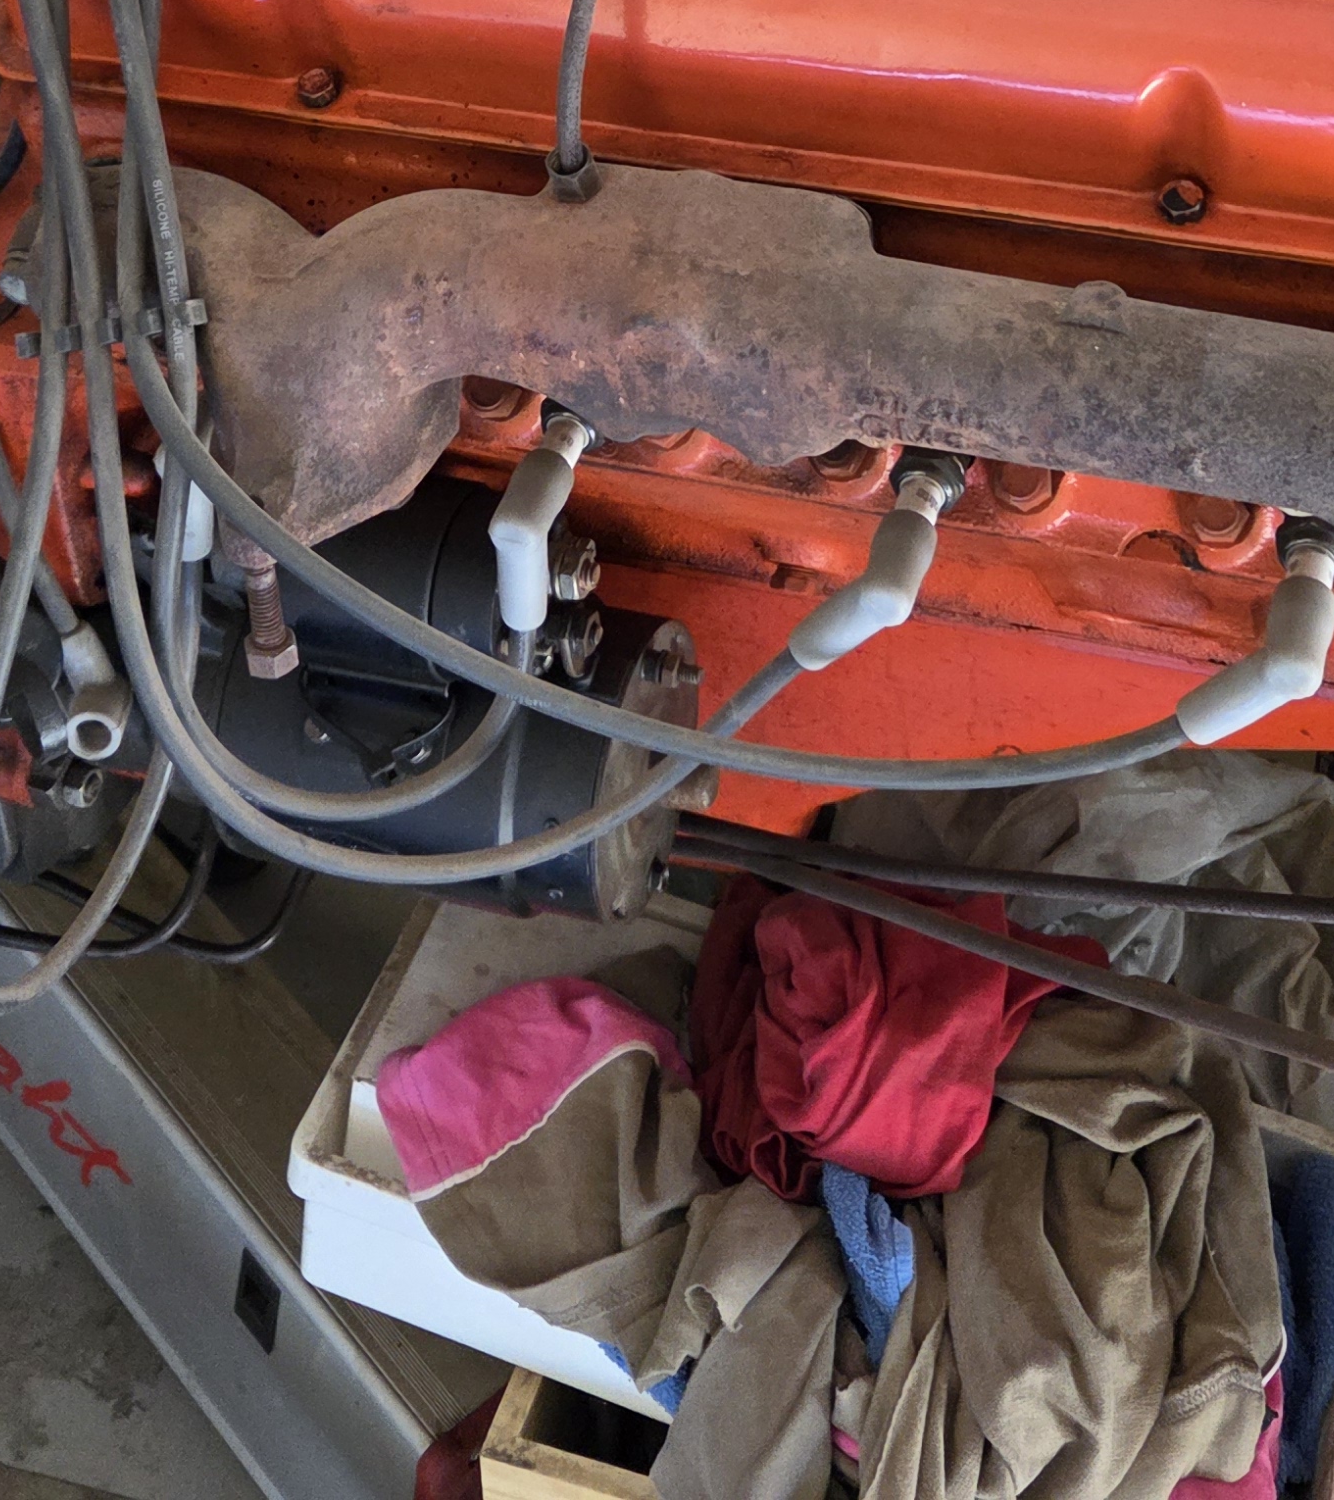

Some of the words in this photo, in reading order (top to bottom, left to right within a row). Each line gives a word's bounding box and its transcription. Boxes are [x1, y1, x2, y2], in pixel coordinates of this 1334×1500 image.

[151, 178, 172, 239] SILICONE
[162, 250, 179, 304] HI-TEMP
[171, 317, 185, 361] CABLE
